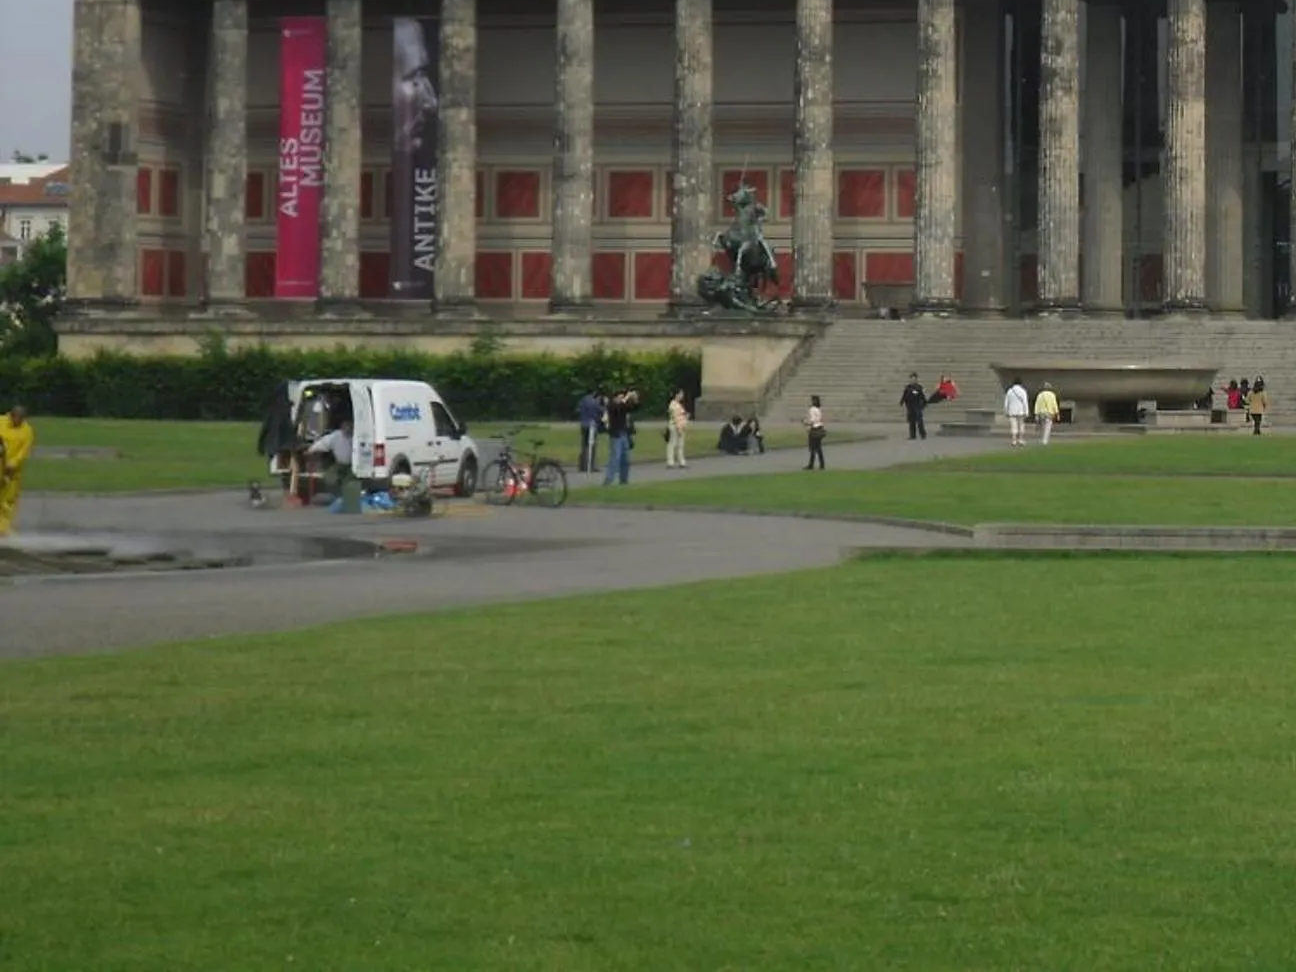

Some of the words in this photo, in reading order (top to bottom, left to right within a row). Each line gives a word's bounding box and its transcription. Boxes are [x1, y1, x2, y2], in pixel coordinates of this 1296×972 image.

[280, 138, 299, 217] ALTES
[300, 69, 325, 187] MUSEUM
[414, 168, 437, 271] ANTIKE
